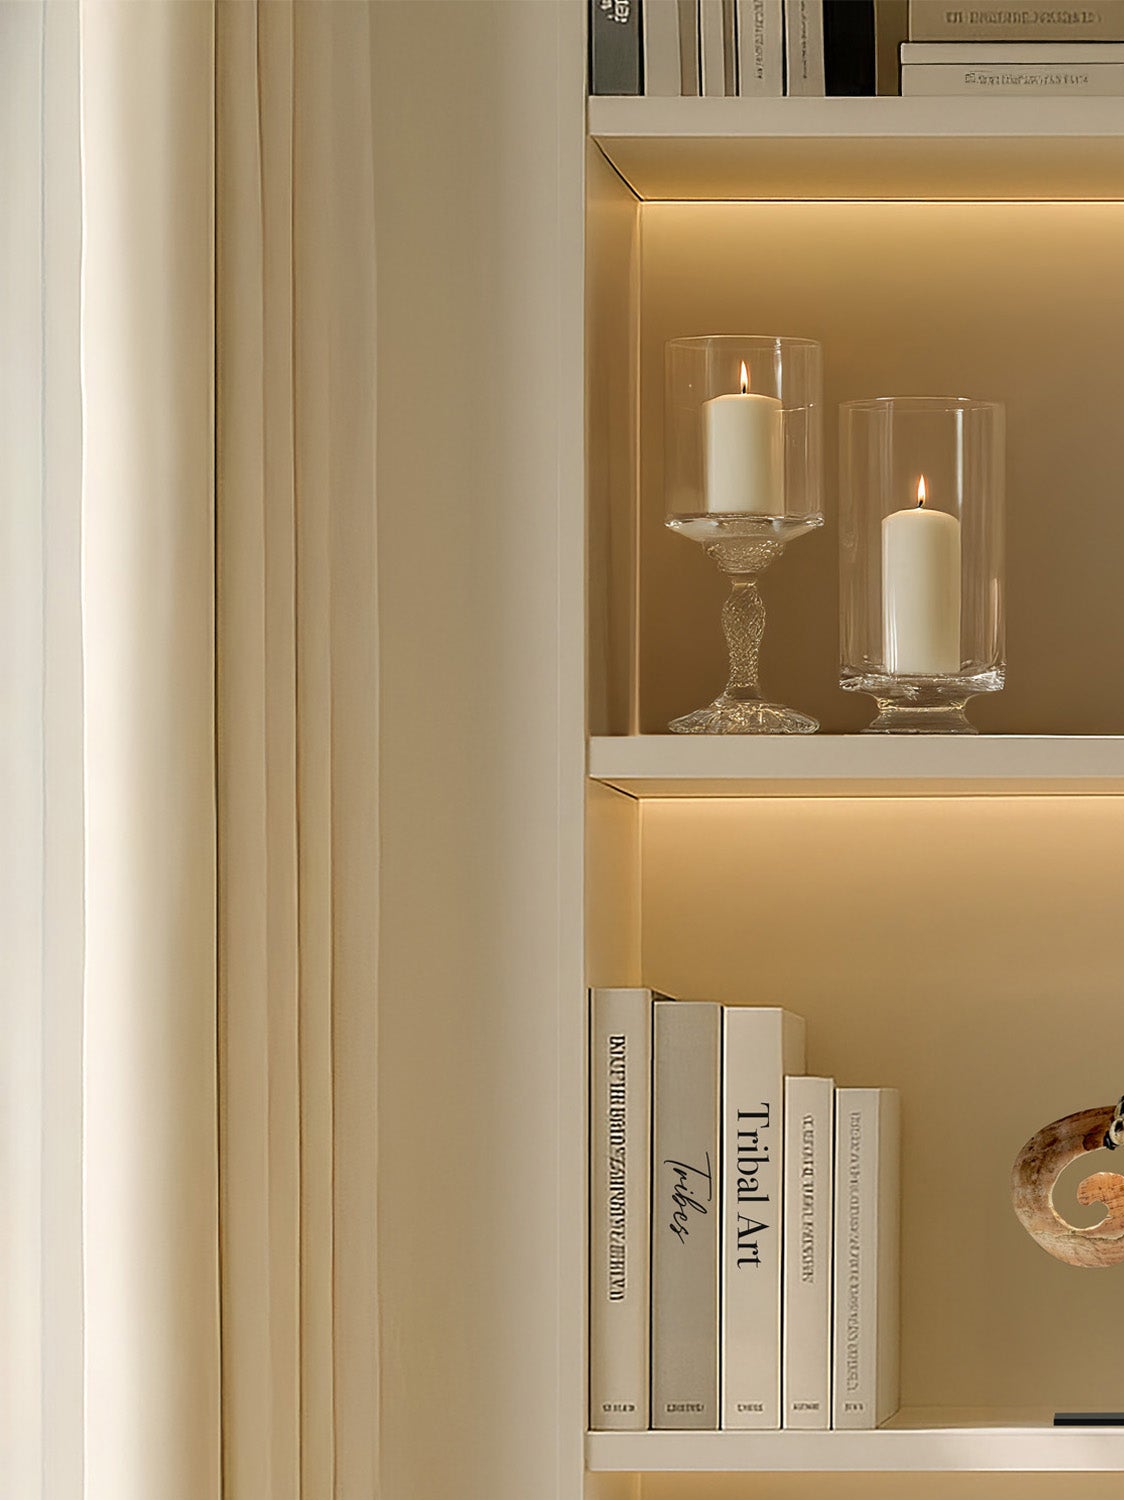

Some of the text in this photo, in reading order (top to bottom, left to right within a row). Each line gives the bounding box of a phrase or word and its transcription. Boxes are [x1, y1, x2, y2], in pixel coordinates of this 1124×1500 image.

[663, 1151, 713, 1245] Tribes
[736, 1102, 771, 1270] Tribal Art
